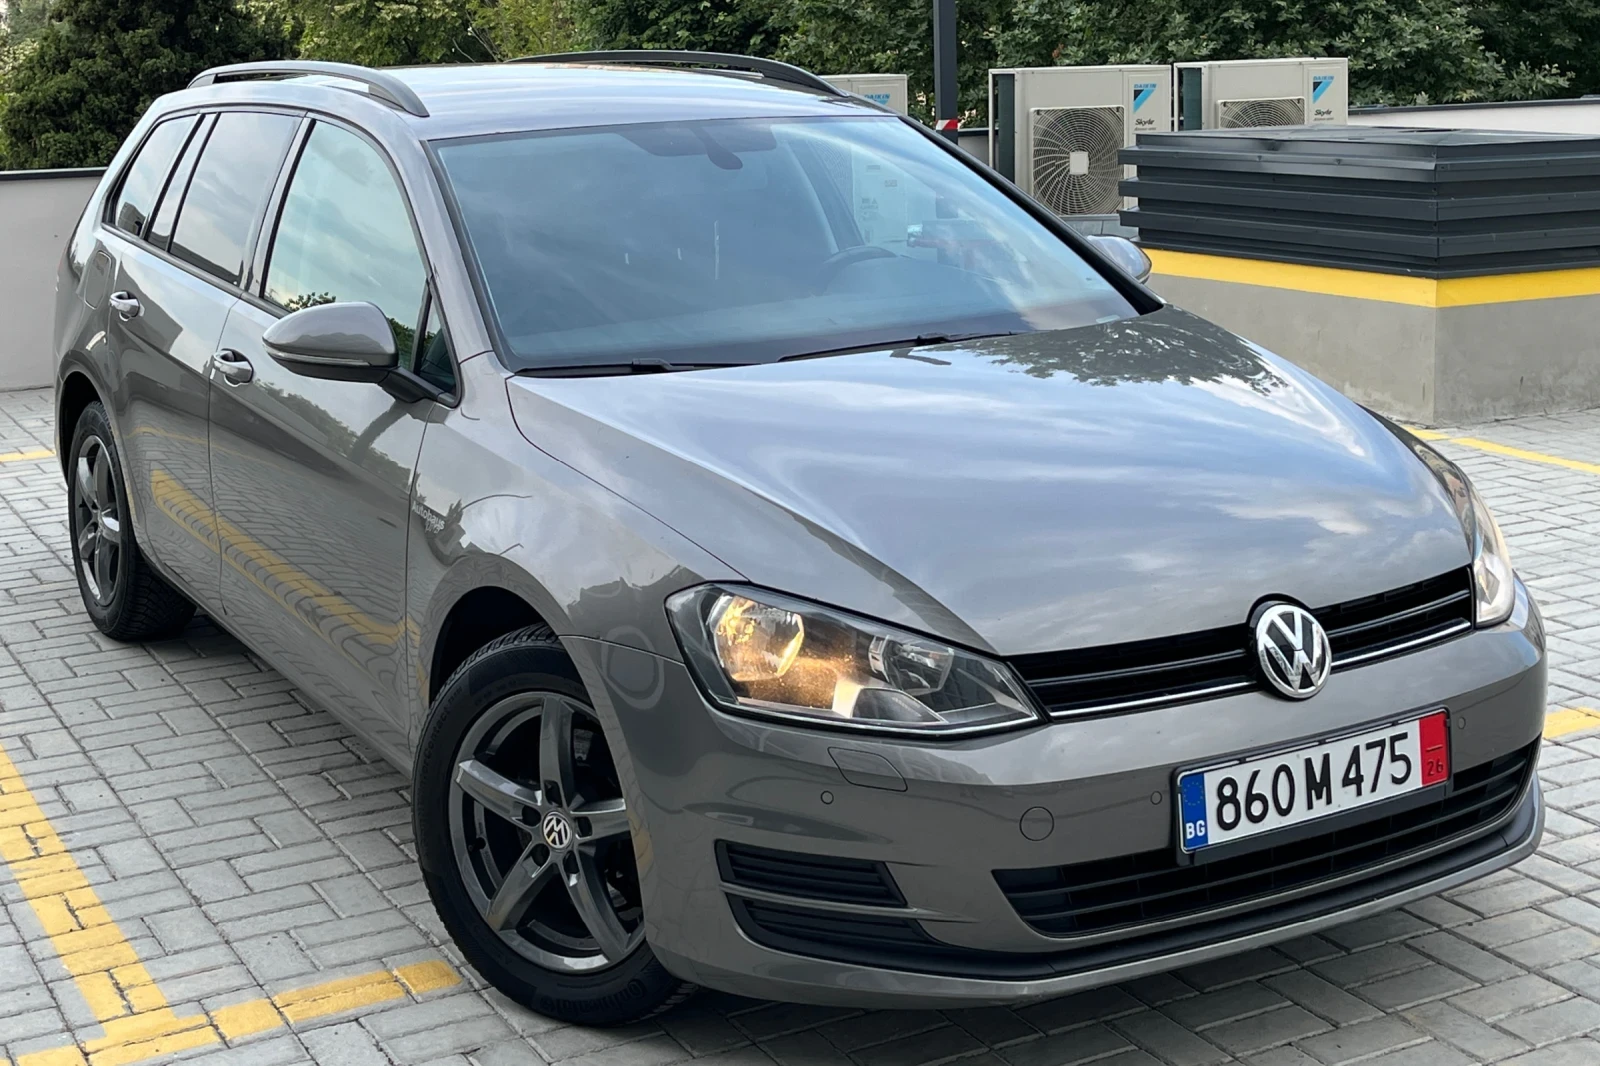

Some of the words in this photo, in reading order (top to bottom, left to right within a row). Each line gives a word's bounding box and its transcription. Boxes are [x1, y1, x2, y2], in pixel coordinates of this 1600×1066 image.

[1256, 600, 1332, 698] VW
[1216, 763, 1296, 831] 860
[1304, 752, 1333, 811] M
[1341, 731, 1412, 797] 475
[1426, 758, 1444, 777] 26
[1185, 820, 1206, 839] BG
